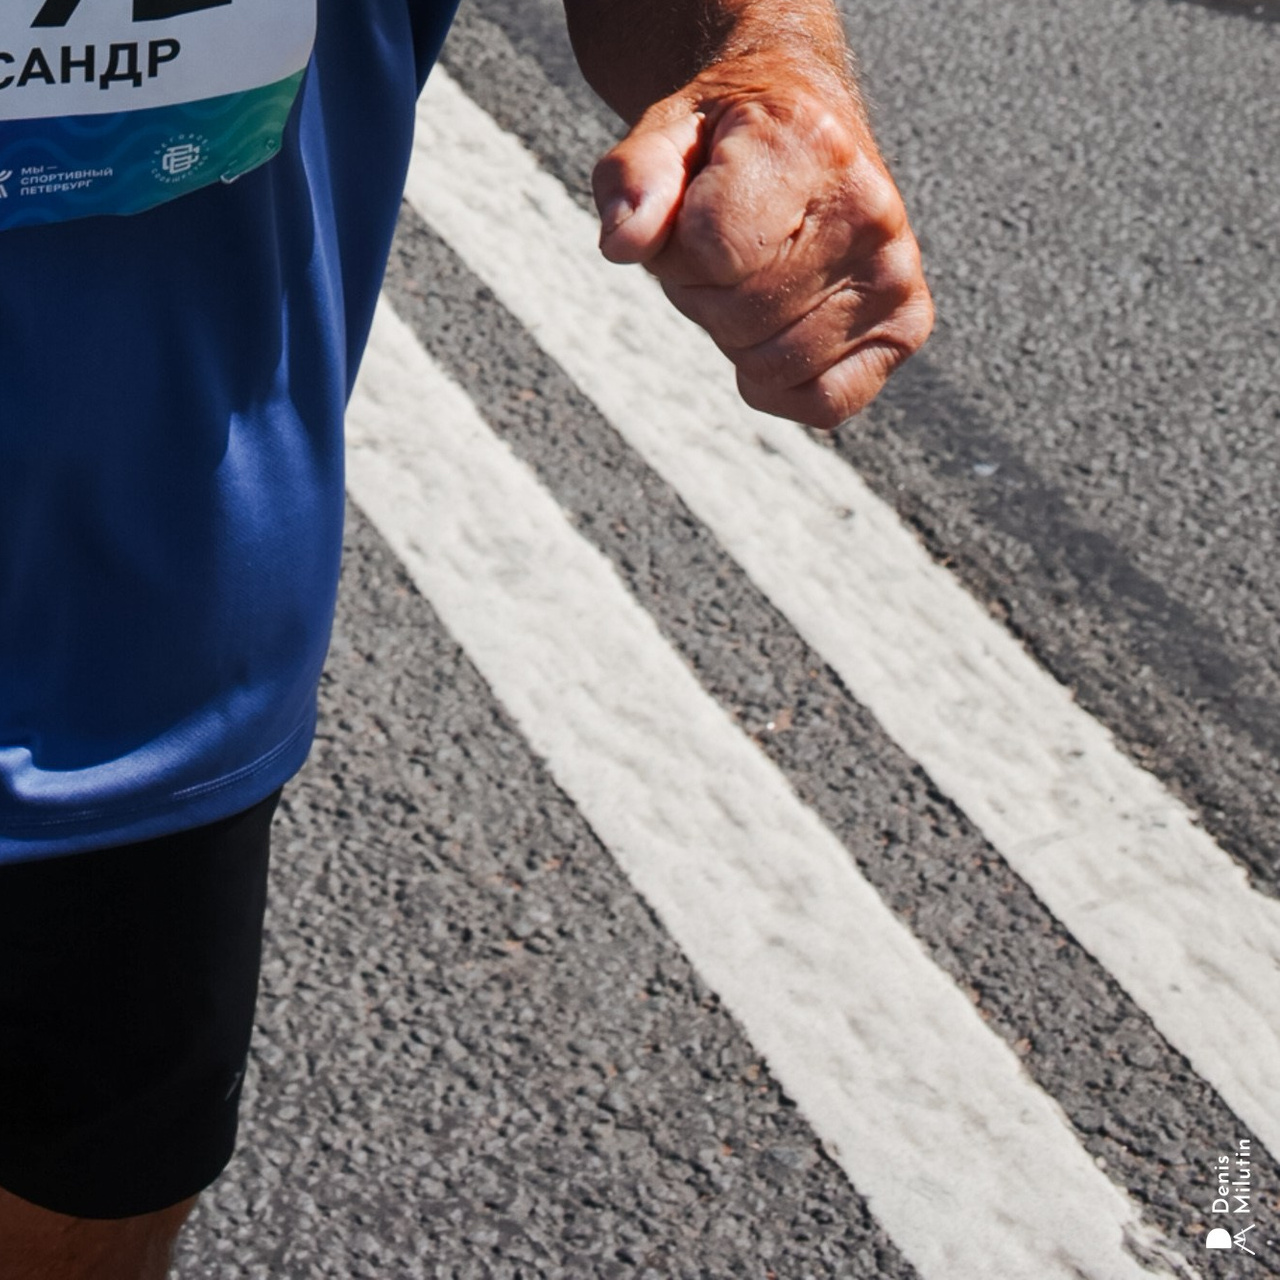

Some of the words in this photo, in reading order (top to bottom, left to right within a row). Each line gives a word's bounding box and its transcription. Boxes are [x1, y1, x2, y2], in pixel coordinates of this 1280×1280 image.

[20, 167, 114, 185] СПОРТИВНЫЙ
[21, 165, 45, 176] МЫ
[20, 179, 93, 196] ПЕТЕРБУРГ
